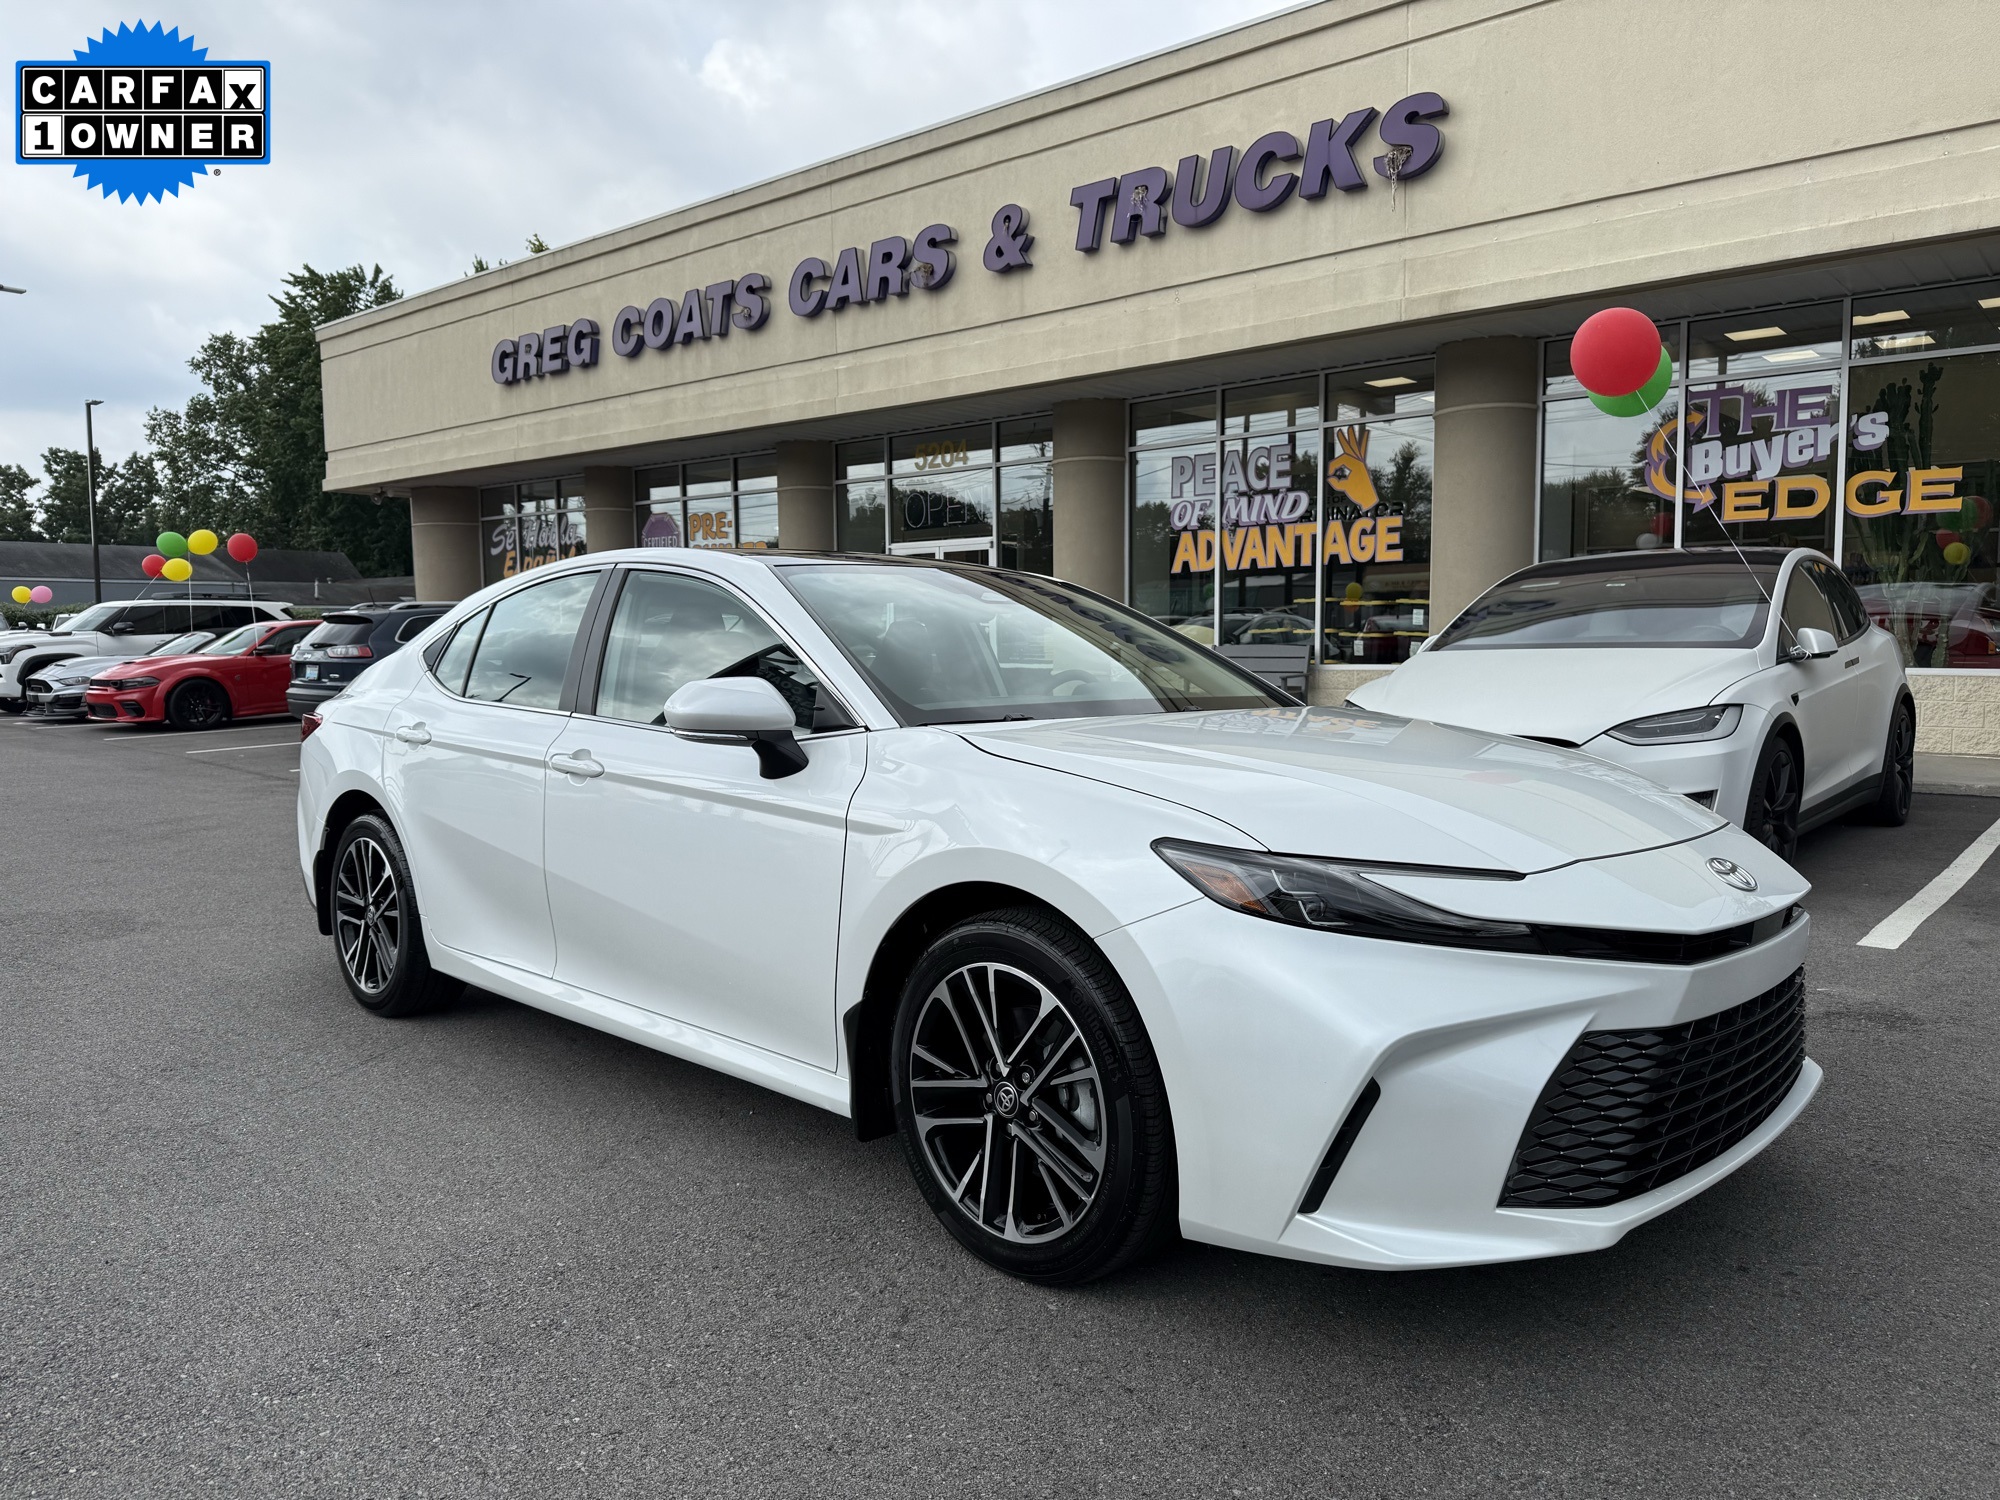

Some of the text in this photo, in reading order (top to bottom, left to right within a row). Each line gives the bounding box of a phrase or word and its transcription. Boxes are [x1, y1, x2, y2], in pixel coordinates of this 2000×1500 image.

[491, 92, 1450, 384] GREG COATS CARS & TRUCKS
[1687, 384, 1834, 438] THE
[914, 439, 969, 471] 5204
[1171, 443, 1292, 499] PEACE
[1690, 411, 1890, 485] Buyer's
[905, 486, 985, 529] OPEN
[1170, 490, 1310, 530] OF MIND
[1721, 466, 1963, 523] EDGE
[490, 523, 516, 555] Se
[689, 511, 733, 541] PRE-
[1171, 515, 1403, 574] ADVANTAGE
